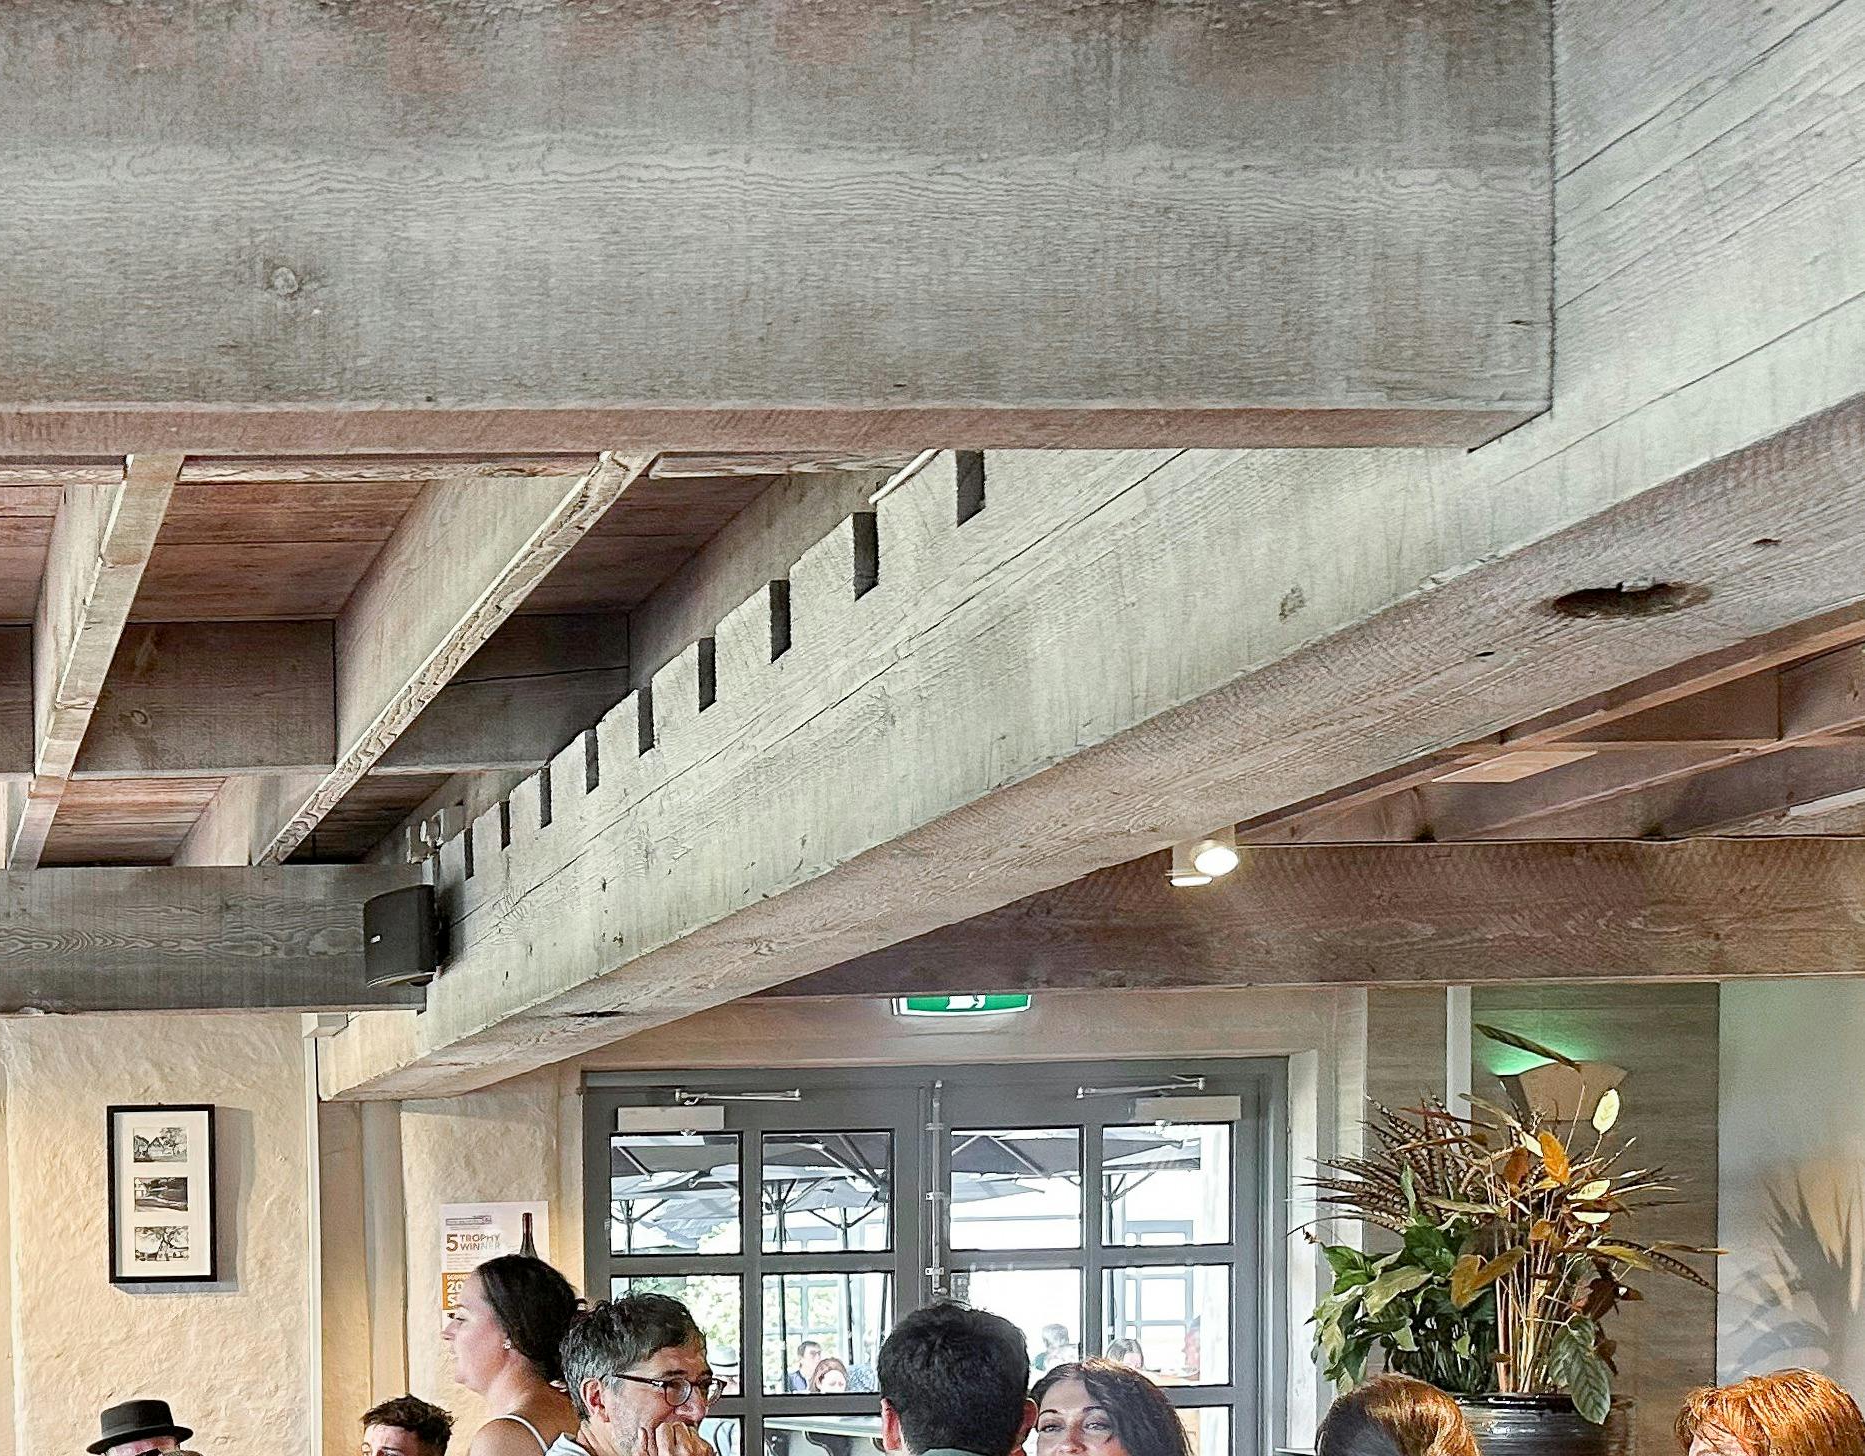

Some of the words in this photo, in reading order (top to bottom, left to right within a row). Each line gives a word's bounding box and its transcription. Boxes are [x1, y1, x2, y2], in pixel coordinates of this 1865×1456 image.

[460, 1233, 501, 1242] TROPHY
[445, 1233, 459, 1252] 5
[460, 1242, 501, 1251] WINNER
